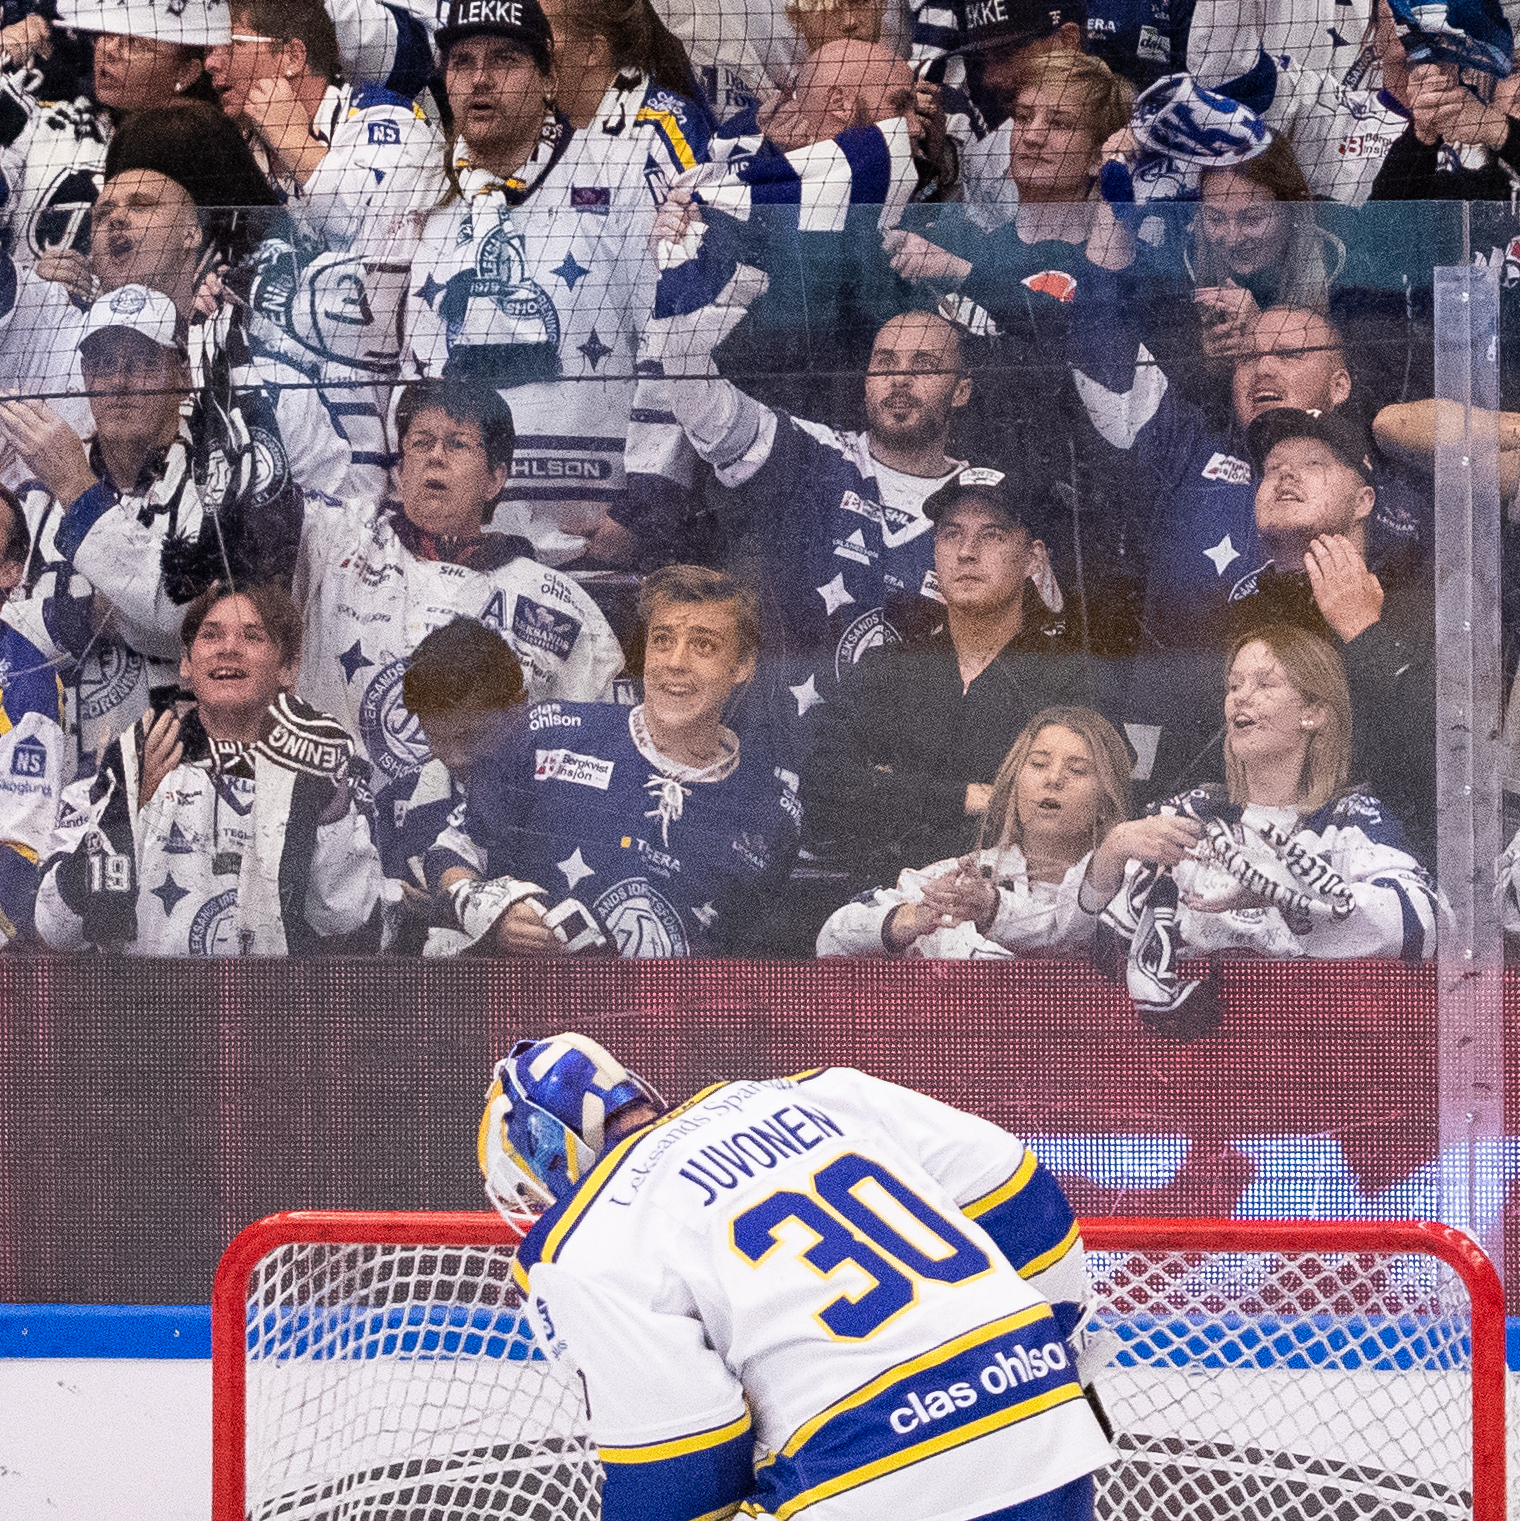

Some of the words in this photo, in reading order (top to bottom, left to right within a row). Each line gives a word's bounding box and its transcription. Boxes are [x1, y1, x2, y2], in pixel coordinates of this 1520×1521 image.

[457, 0, 524, 27] LEKKE
[528, 711, 583, 733] ohlson
[677, 1101, 846, 1208] JUVONEN
[729, 1150, 992, 1343] 30
[887, 1382, 980, 1437] clas
